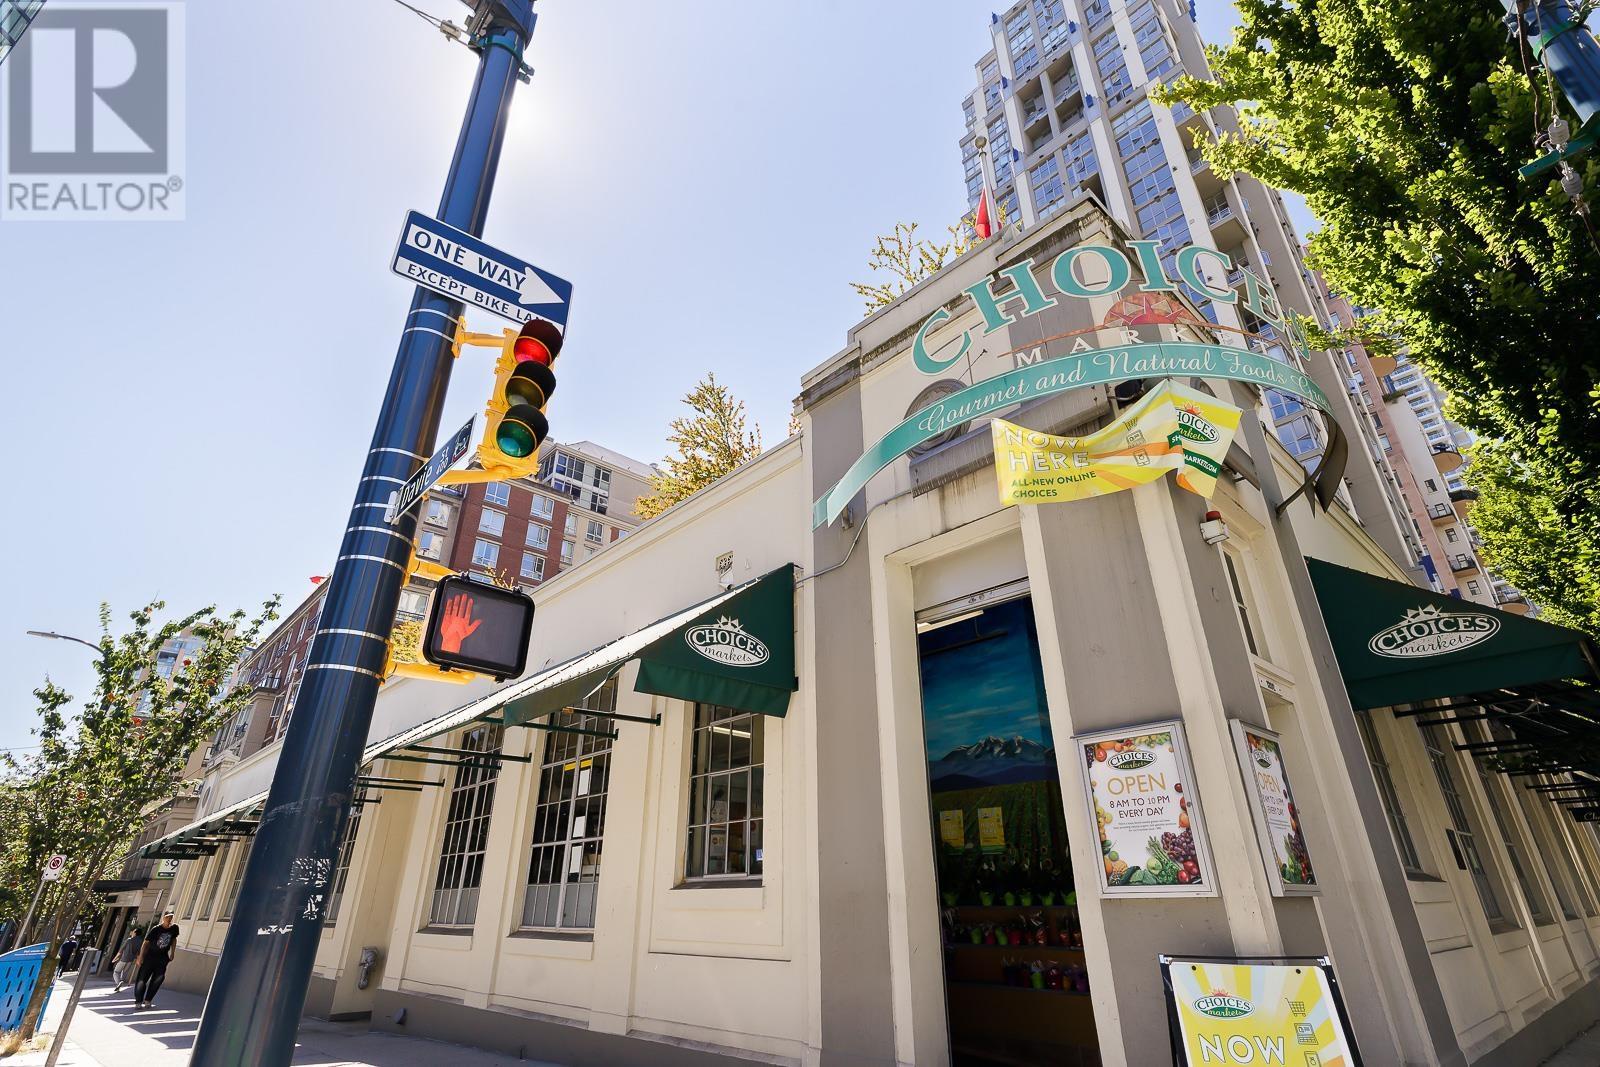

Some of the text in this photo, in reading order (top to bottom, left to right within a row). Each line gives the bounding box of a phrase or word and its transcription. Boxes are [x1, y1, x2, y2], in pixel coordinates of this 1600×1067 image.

[414, 231, 526, 290] ONE WAY
[408, 264, 543, 322] EXCEPT BIKE LA
[919, 348, 1287, 433] Gourmet and Natural Foods
[1177, 412, 1216, 439] HOICES
[1179, 428, 1206, 441] arkets
[1005, 427, 1084, 448] NOW
[1009, 450, 1089, 472] HERE
[400, 466, 433, 509] Davie
[1012, 471, 1096, 487] ALL-NEW ONLINE
[1013, 489, 1057, 498] CHOICES
[692, 629, 764, 658] CHOICES
[1377, 617, 1490, 650] CHOICES
[704, 646, 753, 662] markets
[1400, 634, 1477, 654] markets
[1110, 752, 1154, 766] CHOICES
[1107, 772, 1166, 795] OPEN
[1109, 795, 1170, 808] 8 AM TO 10 PM
[1119, 807, 1164, 818] EVERY DAY
[218, 825, 245, 834] Choices
[1195, 997, 1250, 1010] CHOICES
[1206, 1007, 1244, 1017] markets
[1198, 1033, 1284, 1065] NOW
